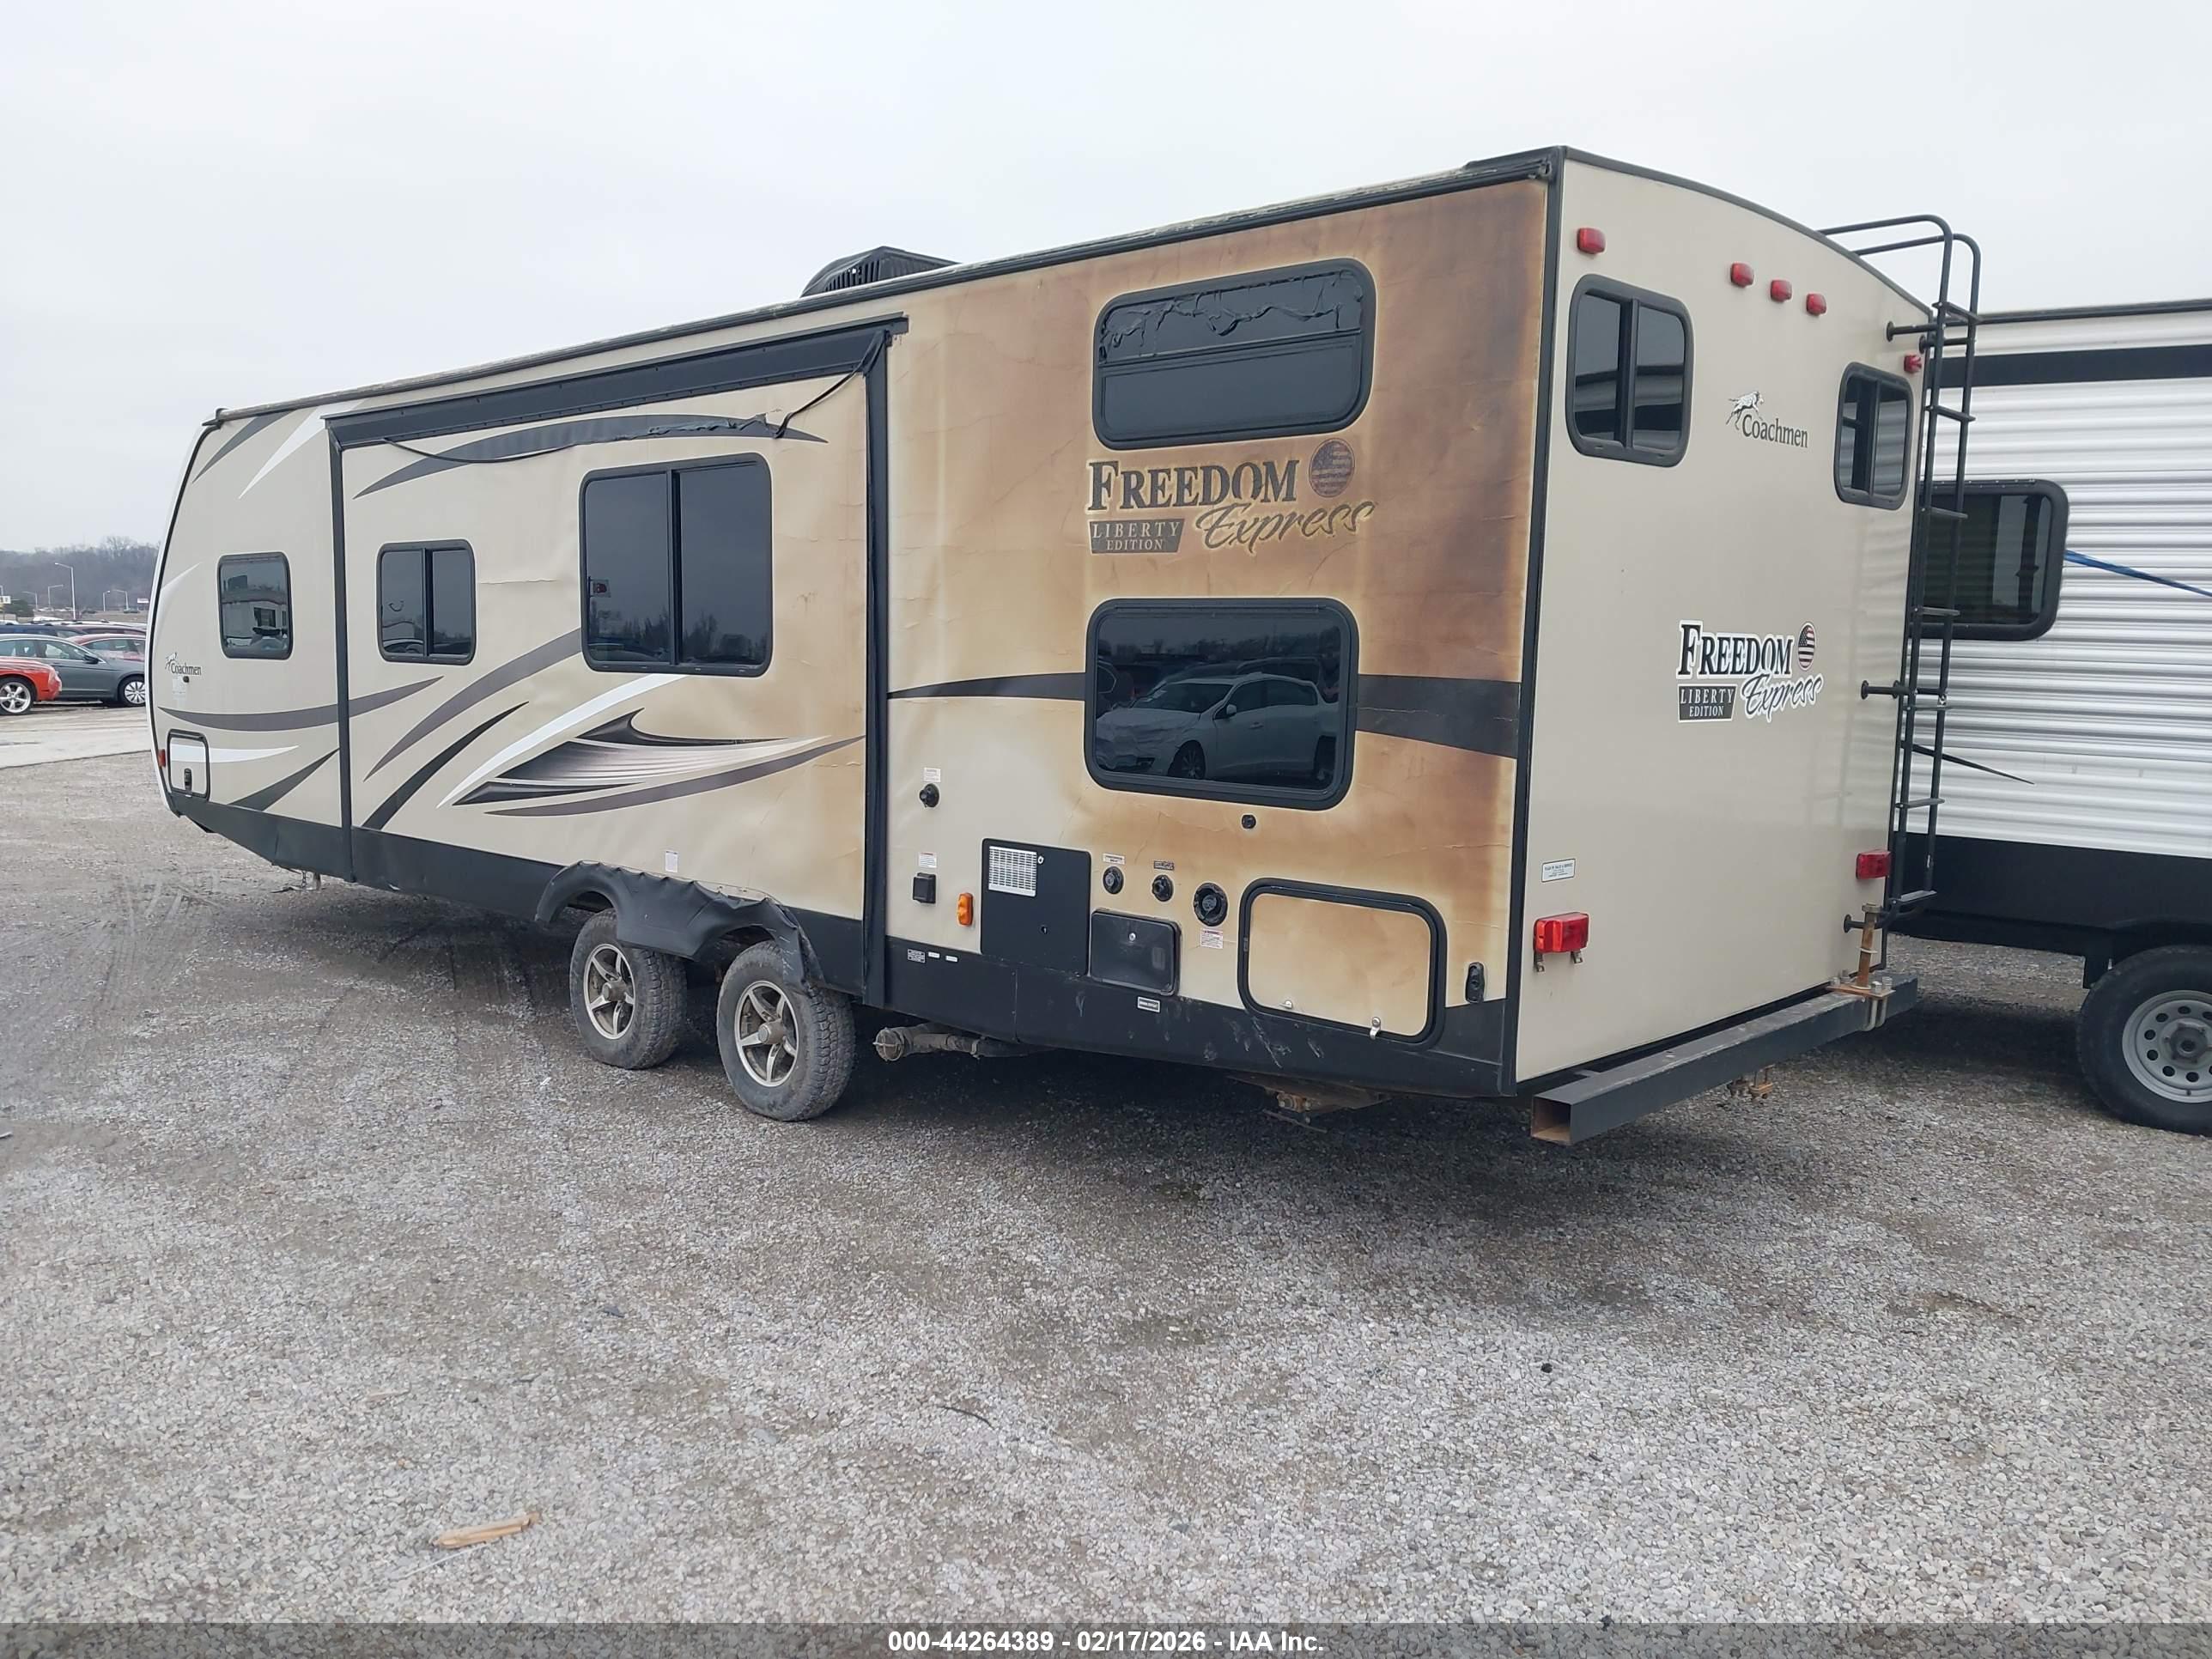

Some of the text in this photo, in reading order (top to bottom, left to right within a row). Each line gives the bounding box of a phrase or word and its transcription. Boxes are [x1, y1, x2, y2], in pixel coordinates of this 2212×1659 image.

[1741, 414, 1808, 448] Coachmen
[1087, 459, 1300, 511] FREEDOM
[1091, 520, 1181, 539] LIBERTY
[1195, 500, 1376, 554] Express
[1105, 538, 1165, 551] EDITION
[1677, 623, 1793, 676] FREEDOM
[171, 662, 202, 676] Coachmen
[1680, 687, 1735, 704] LIBERTY
[1741, 673, 1822, 720] Express
[1689, 705, 1725, 717] EDITION
